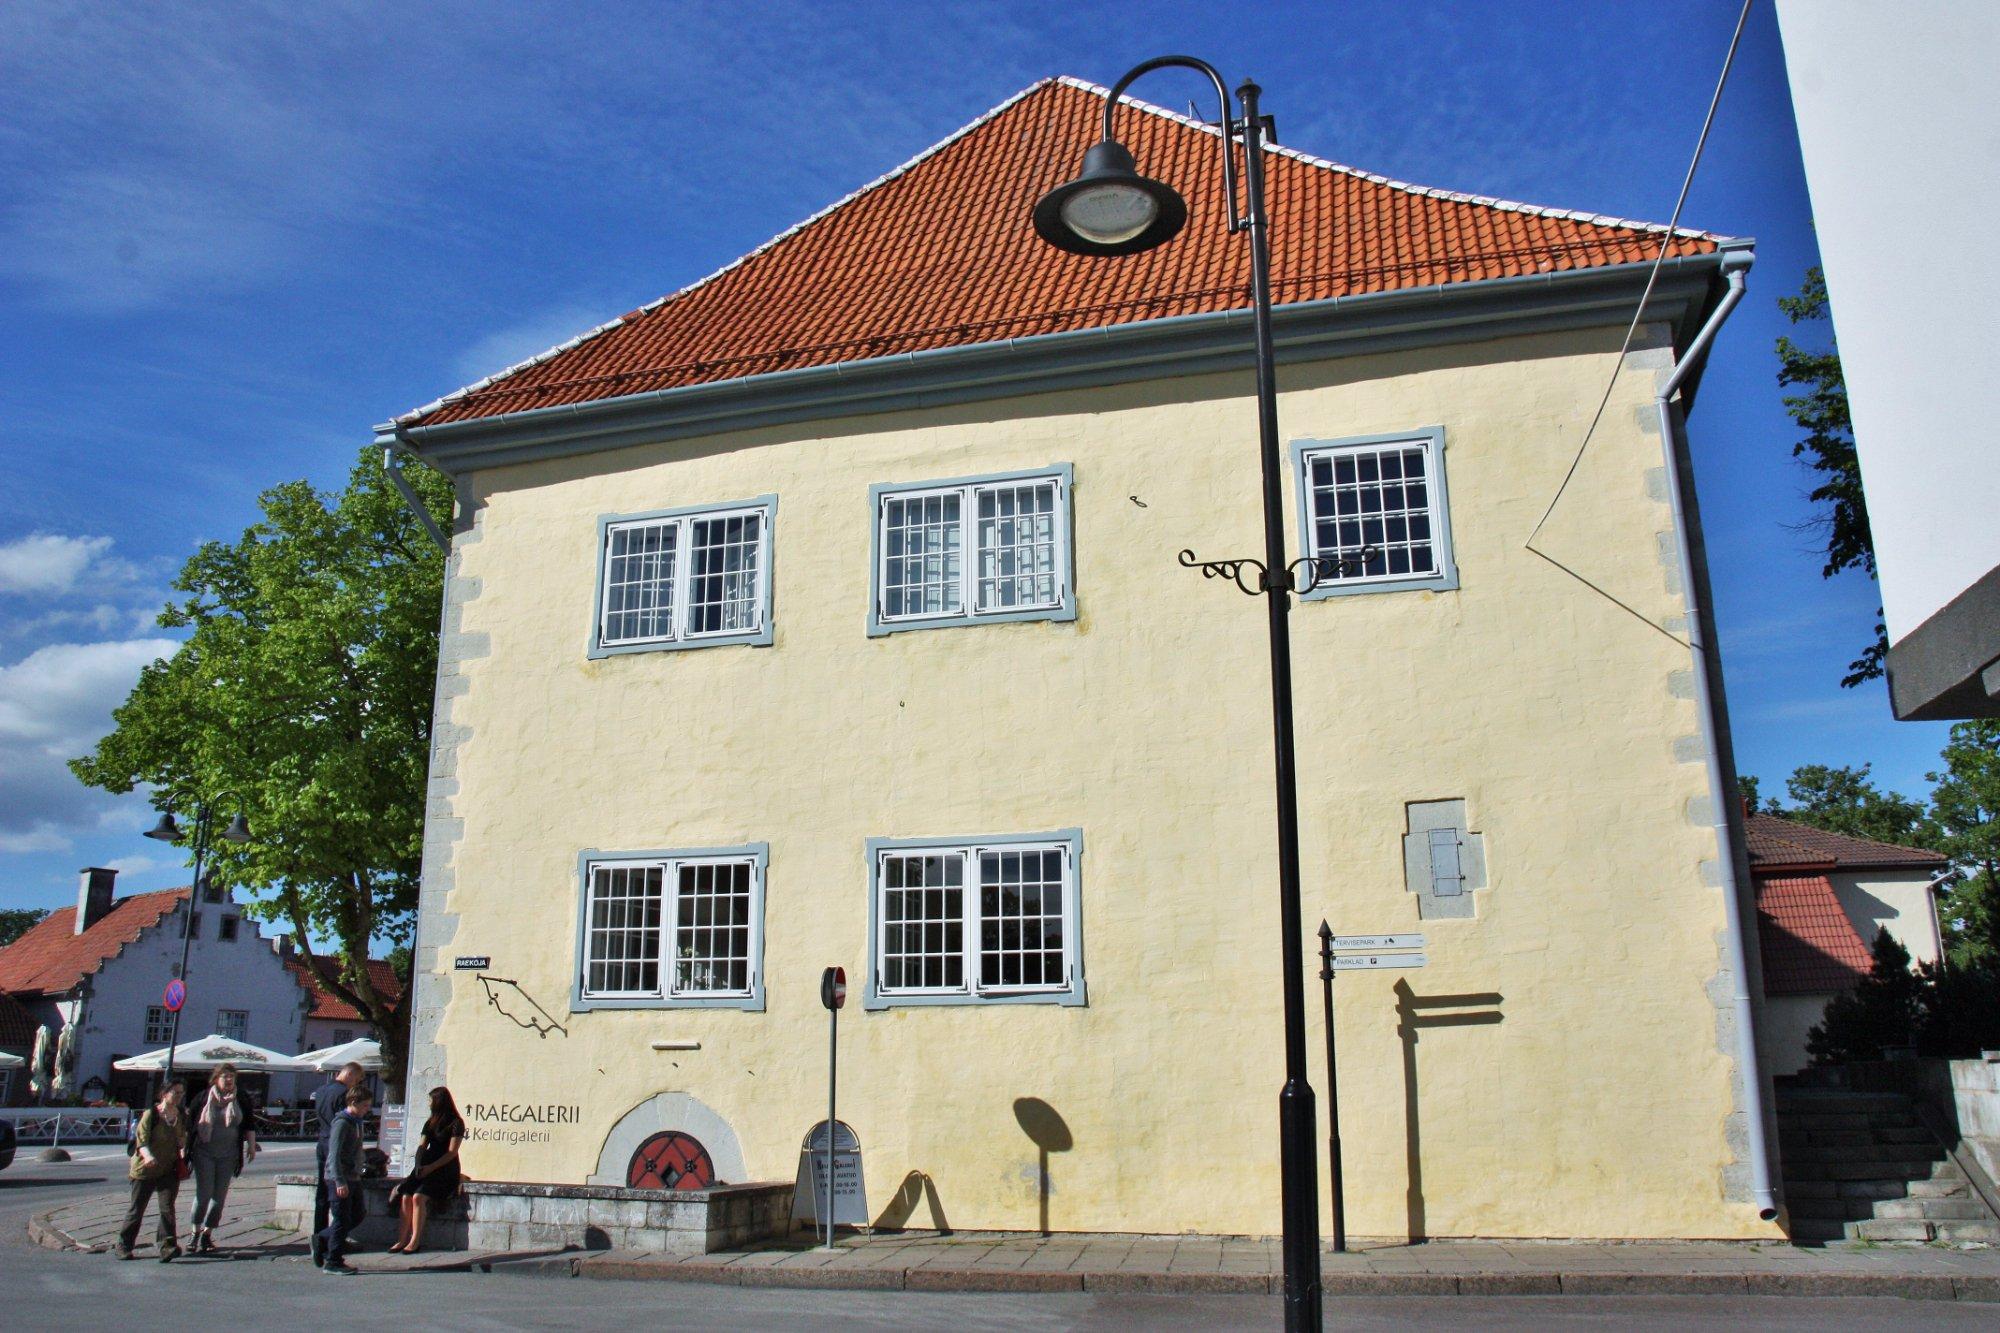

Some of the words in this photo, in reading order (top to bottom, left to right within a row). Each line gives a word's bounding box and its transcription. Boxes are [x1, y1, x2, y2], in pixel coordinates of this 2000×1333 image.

[456, 959, 487, 967] RAEKOJA
[475, 1104, 580, 1123] RAEGALERII
[473, 1127, 550, 1146] Keldrigalerii
